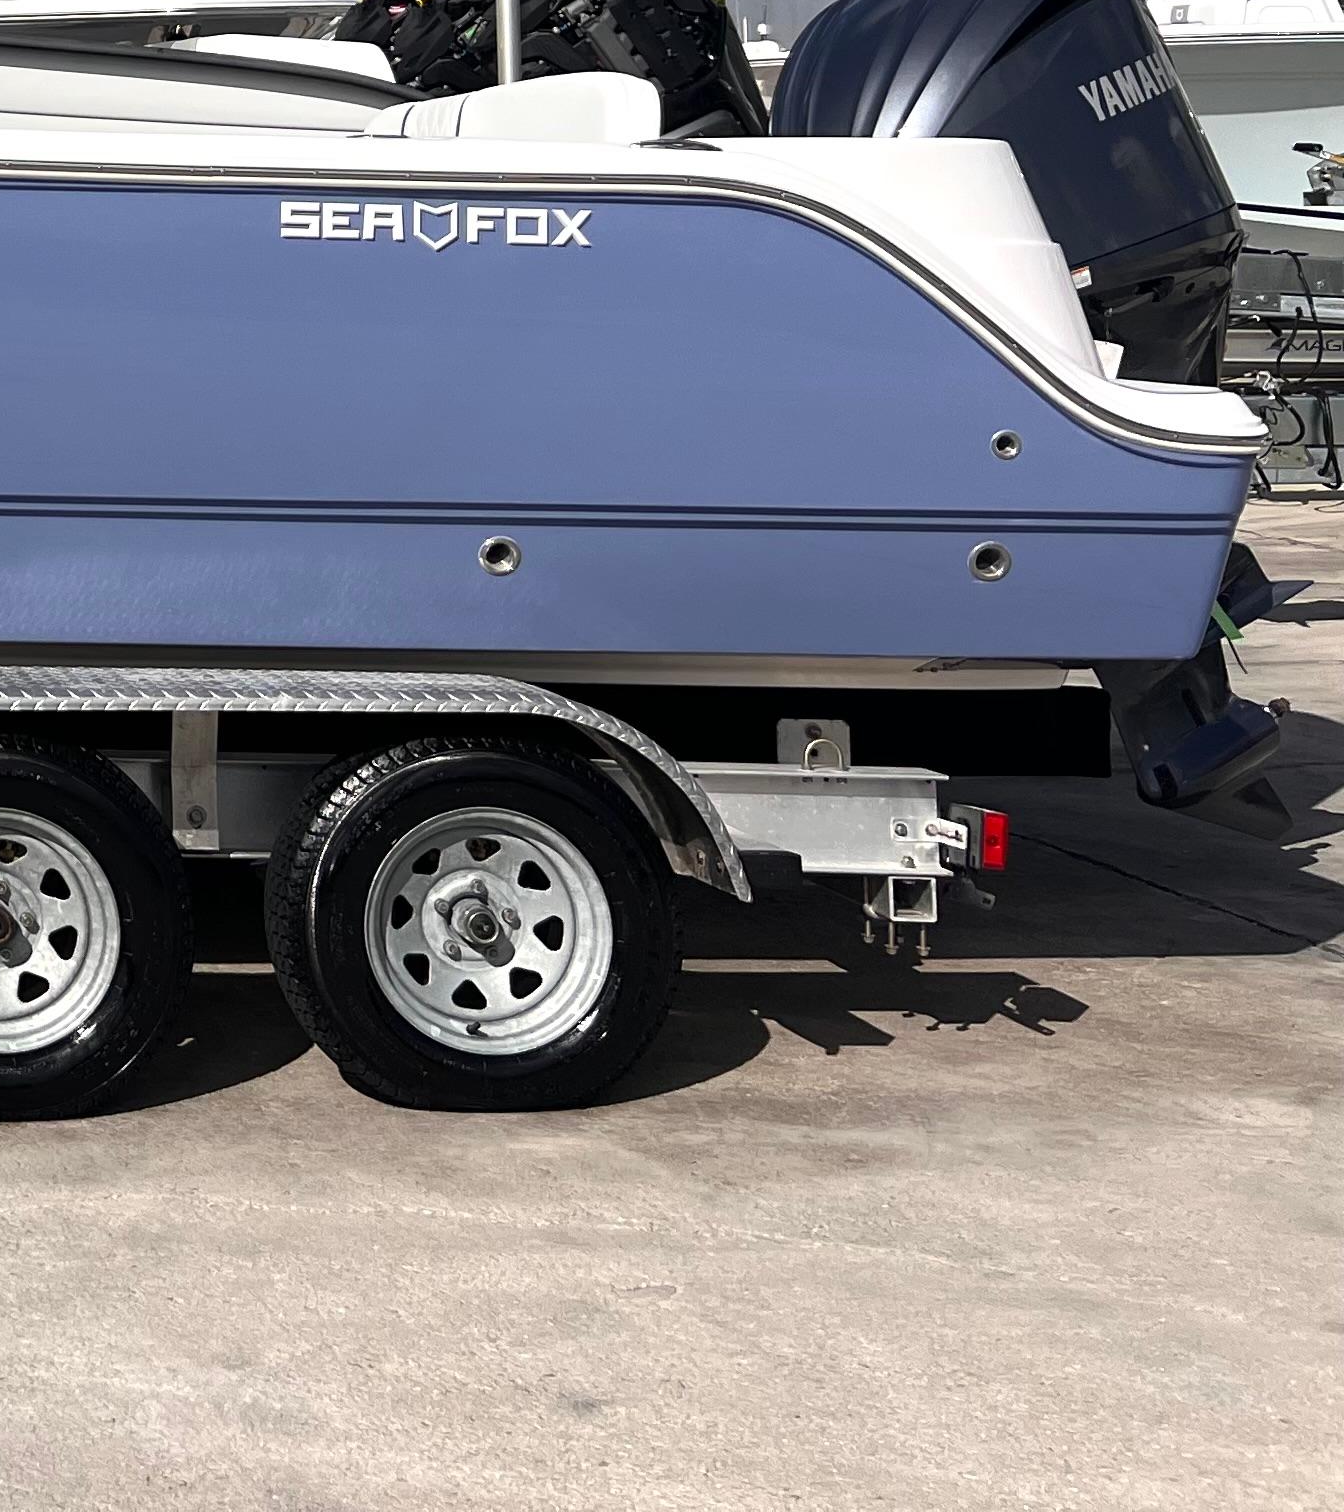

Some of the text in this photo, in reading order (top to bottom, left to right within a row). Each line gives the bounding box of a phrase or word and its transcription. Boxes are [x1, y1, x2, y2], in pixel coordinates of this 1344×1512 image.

[1078, 52, 1177, 121] YAMAH
[280, 201, 592, 247] SEA FOX
[1288, 339, 1344, 352] MAG
